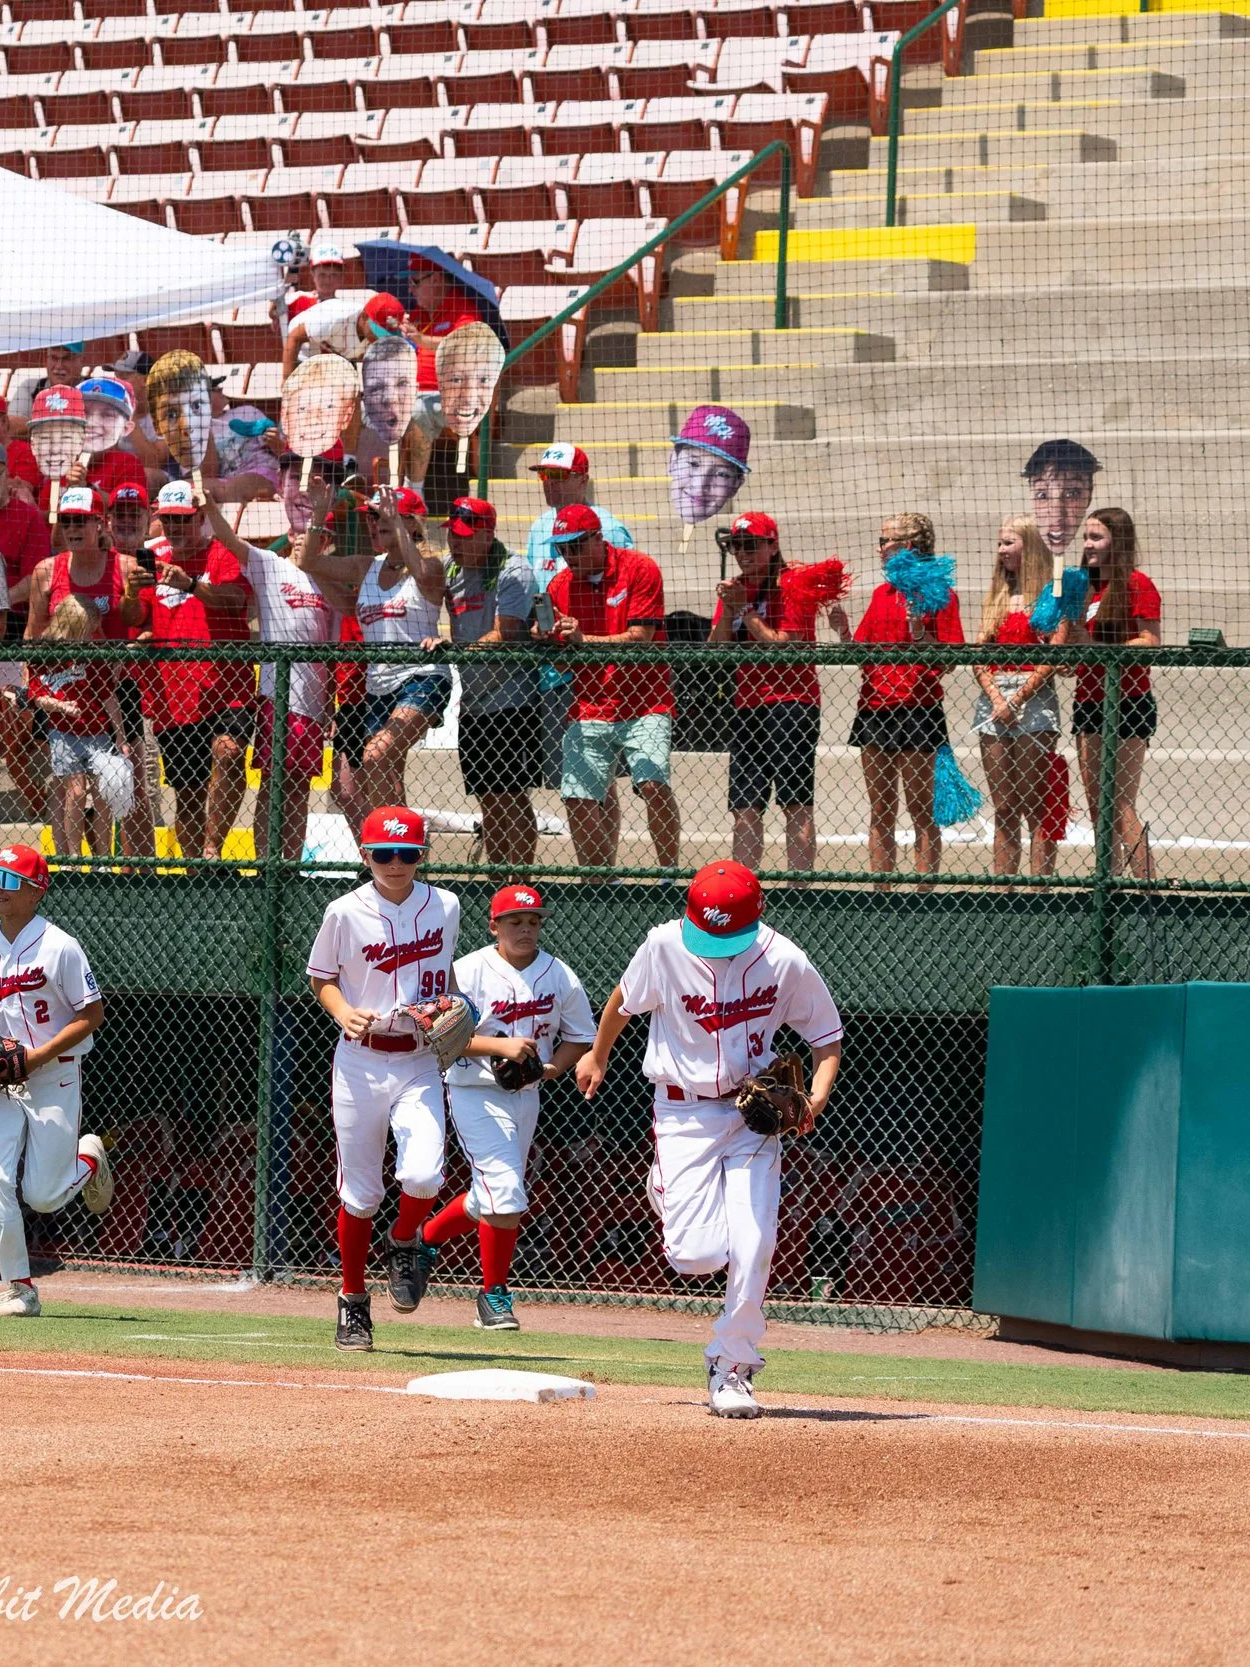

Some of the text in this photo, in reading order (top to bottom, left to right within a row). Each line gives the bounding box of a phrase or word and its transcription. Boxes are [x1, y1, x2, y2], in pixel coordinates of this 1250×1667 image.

[383, 816, 410, 840] MH
[514, 891, 536, 906] MH
[702, 905, 733, 926] MH
[361, 927, 444, 961] Murrayhill
[421, 970, 446, 997] 99
[681, 984, 778, 1015] Murrayhill
[34, 1000, 49, 1024] 2
